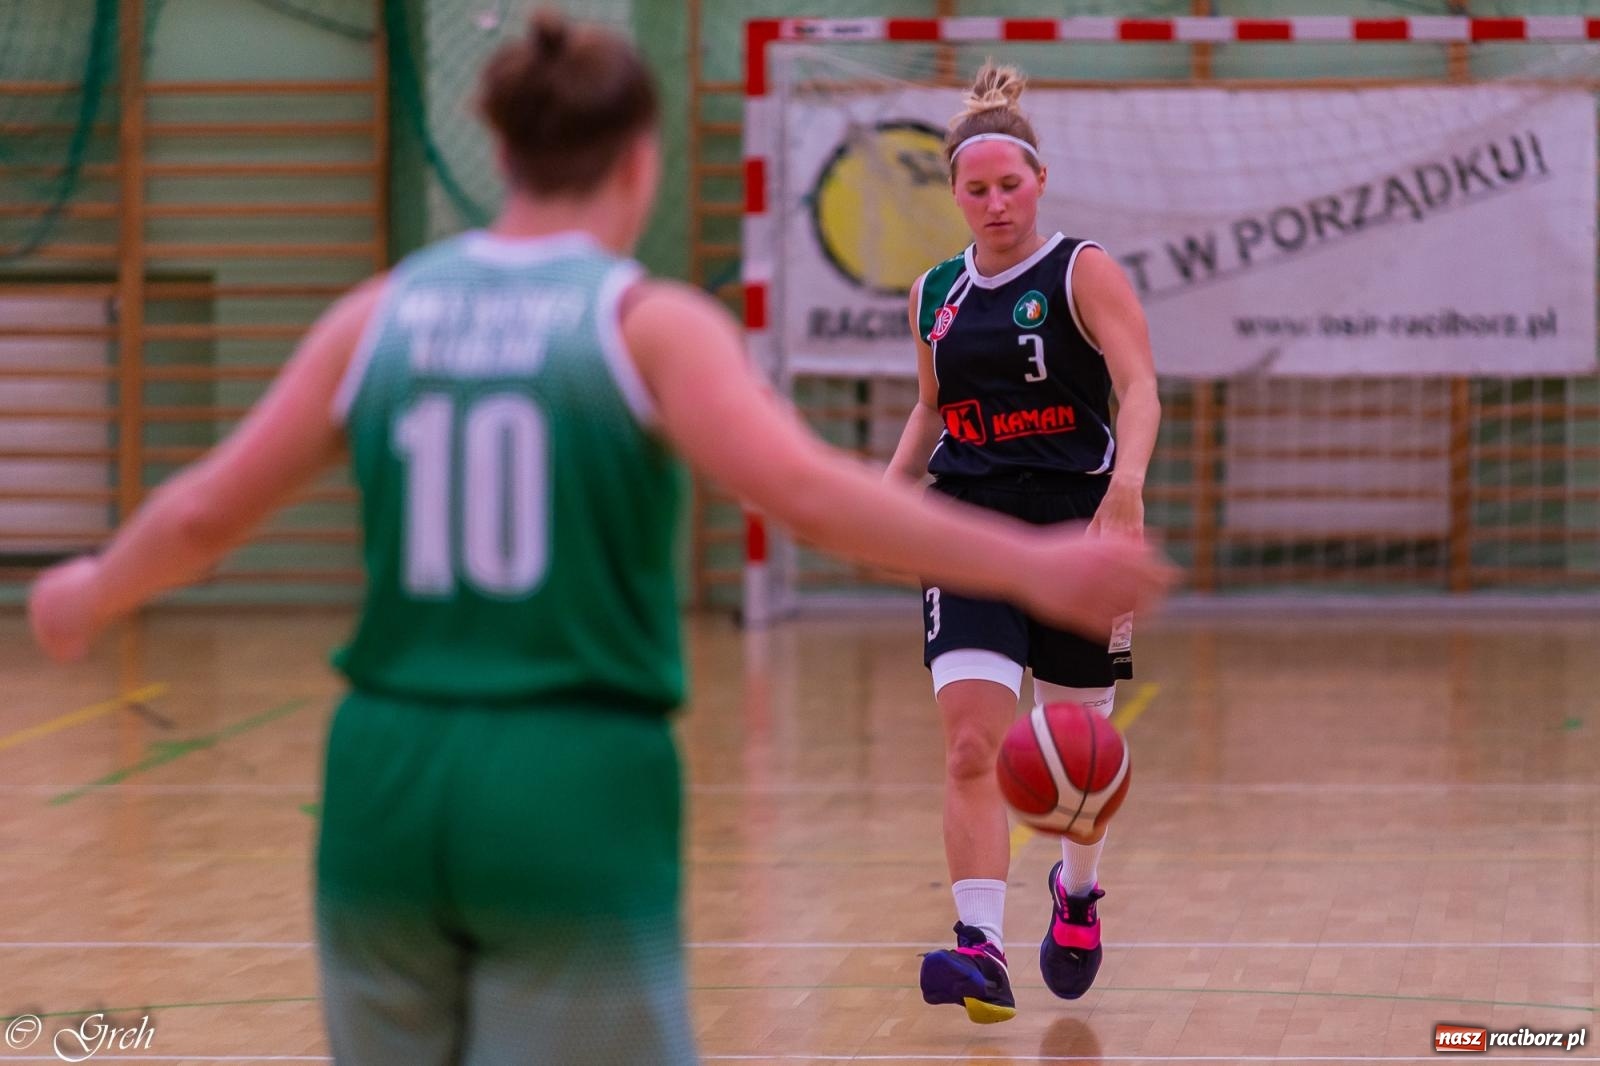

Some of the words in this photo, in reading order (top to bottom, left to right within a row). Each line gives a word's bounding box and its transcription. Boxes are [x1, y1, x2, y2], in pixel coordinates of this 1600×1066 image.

[1166, 233, 1218, 284] W
[1231, 130, 1550, 269] PORZĄDKU!
[1018, 333, 1048, 383] 3
[992, 405, 1076, 436] KAMAN
[390, 389, 553, 599] 10
[925, 586, 941, 643] 3
